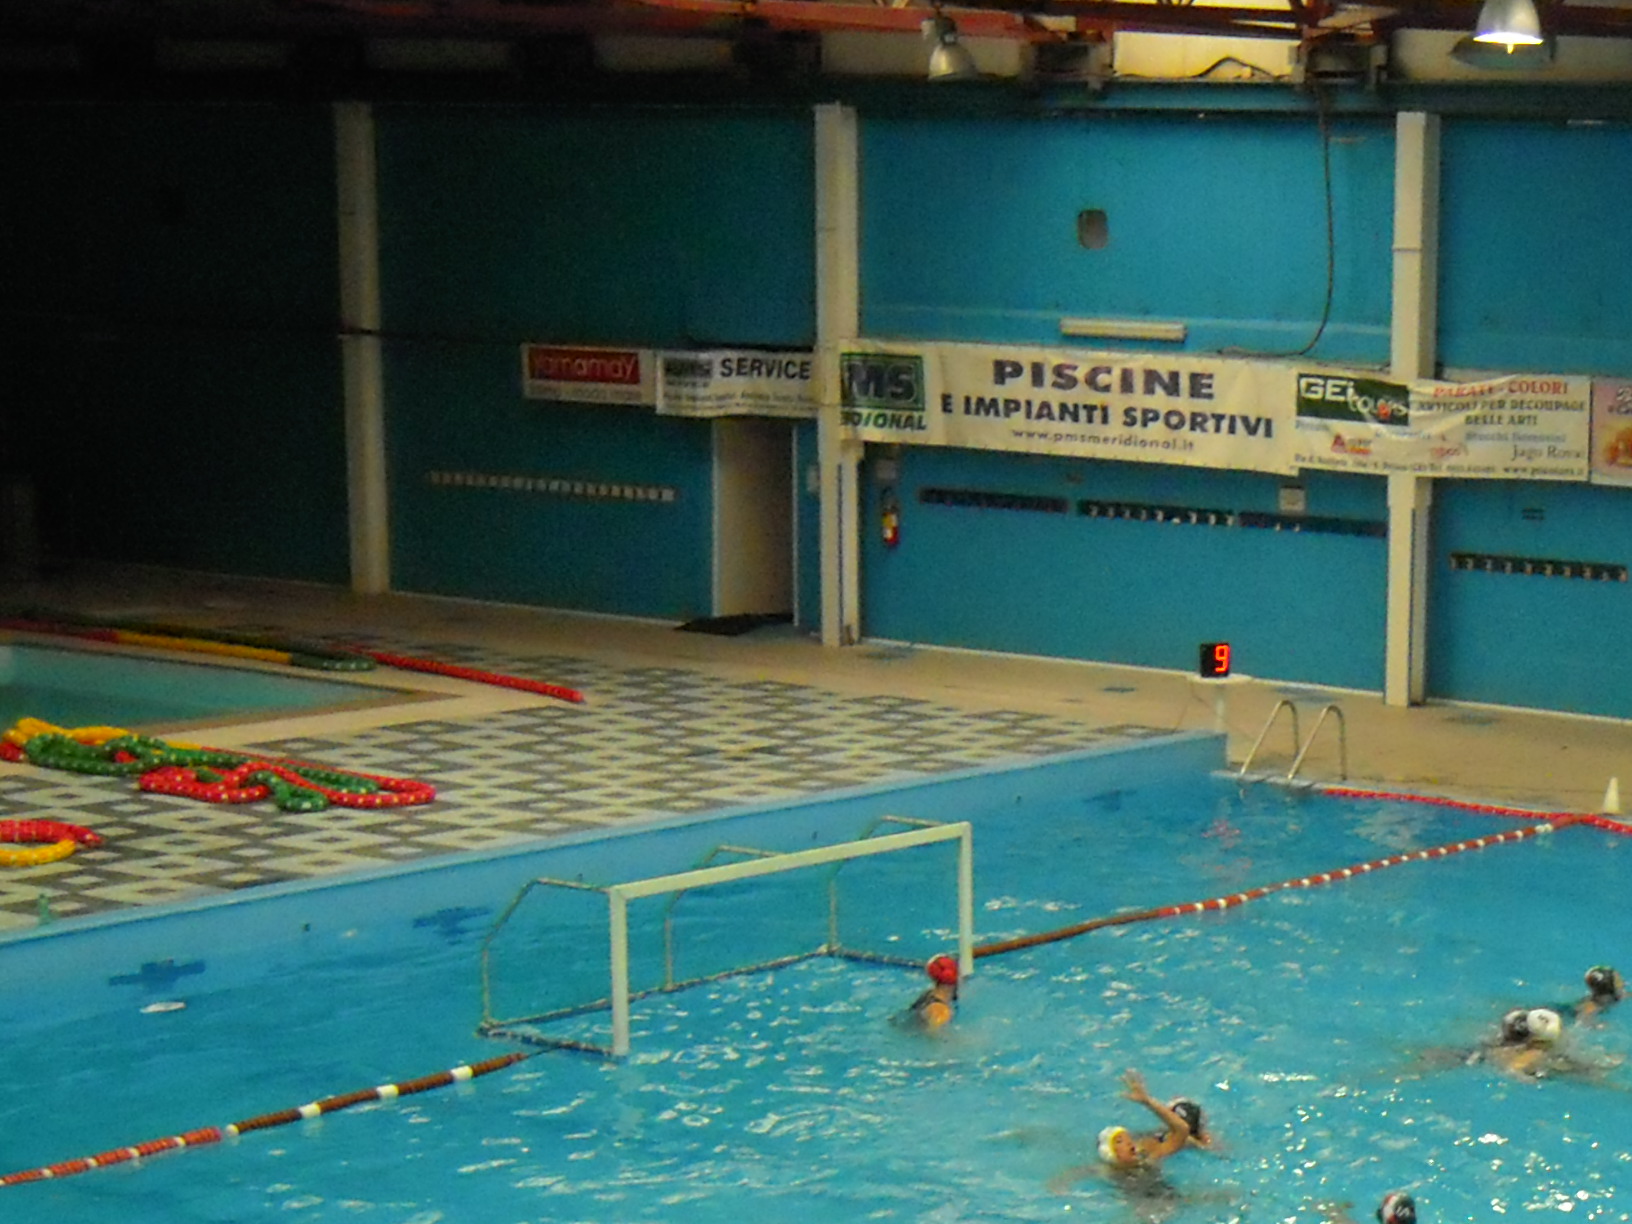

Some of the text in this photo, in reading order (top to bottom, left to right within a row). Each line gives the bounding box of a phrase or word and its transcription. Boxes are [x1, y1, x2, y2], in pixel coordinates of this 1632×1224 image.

[720, 358, 812, 380] SERVICE
[993, 360, 1215, 401] PISCINE
[941, 393, 1273, 439] E IMPIANTI SPORTIVI
[1215, 645, 1229, 672] 9
